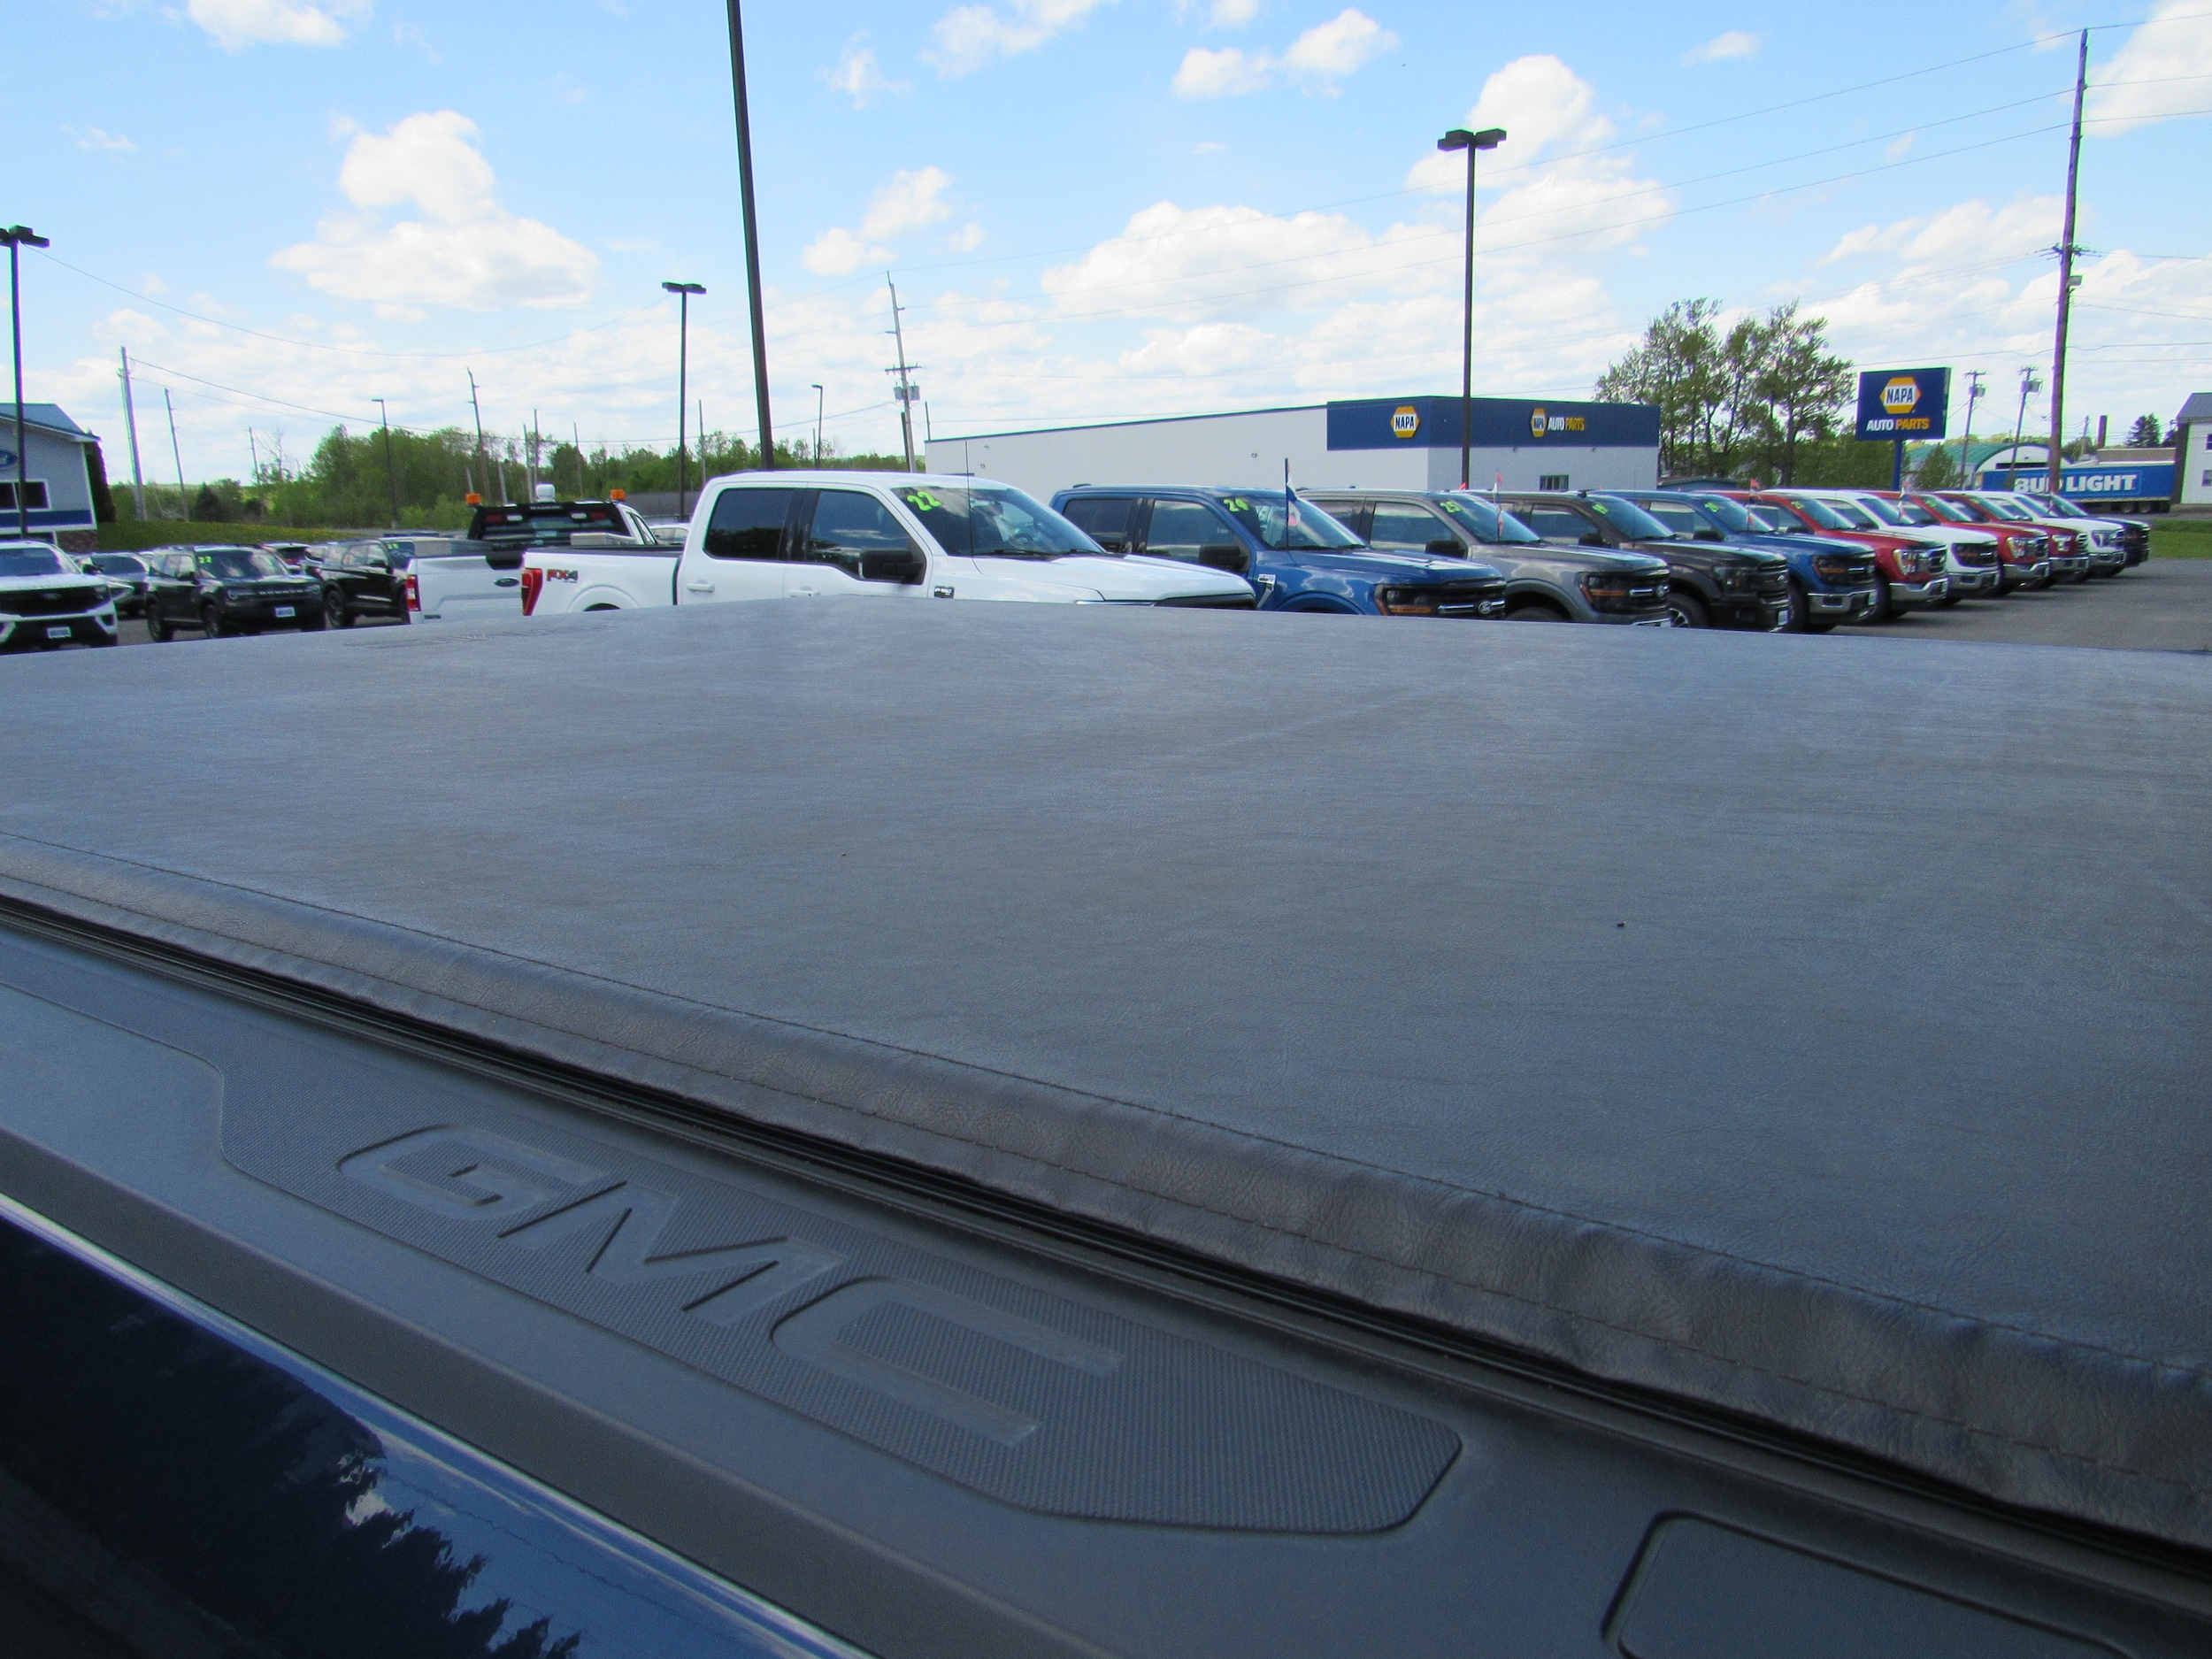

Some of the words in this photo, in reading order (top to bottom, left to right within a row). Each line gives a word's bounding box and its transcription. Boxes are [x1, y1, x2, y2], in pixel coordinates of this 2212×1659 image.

[1886, 388, 1914, 404] NAPA
[1394, 415, 1415, 430] NAPA
[1548, 417, 1565, 431] AUTO
[1565, 417, 1586, 431] PARTS
[1865, 419, 1893, 432] AUTO
[1894, 417, 1931, 430] PARTS
[2065, 474, 2138, 492] LIGHT
[906, 491, 942, 511] 22
[546, 569, 579, 581] FX4
[334, 1122, 1125, 1451] GMC
